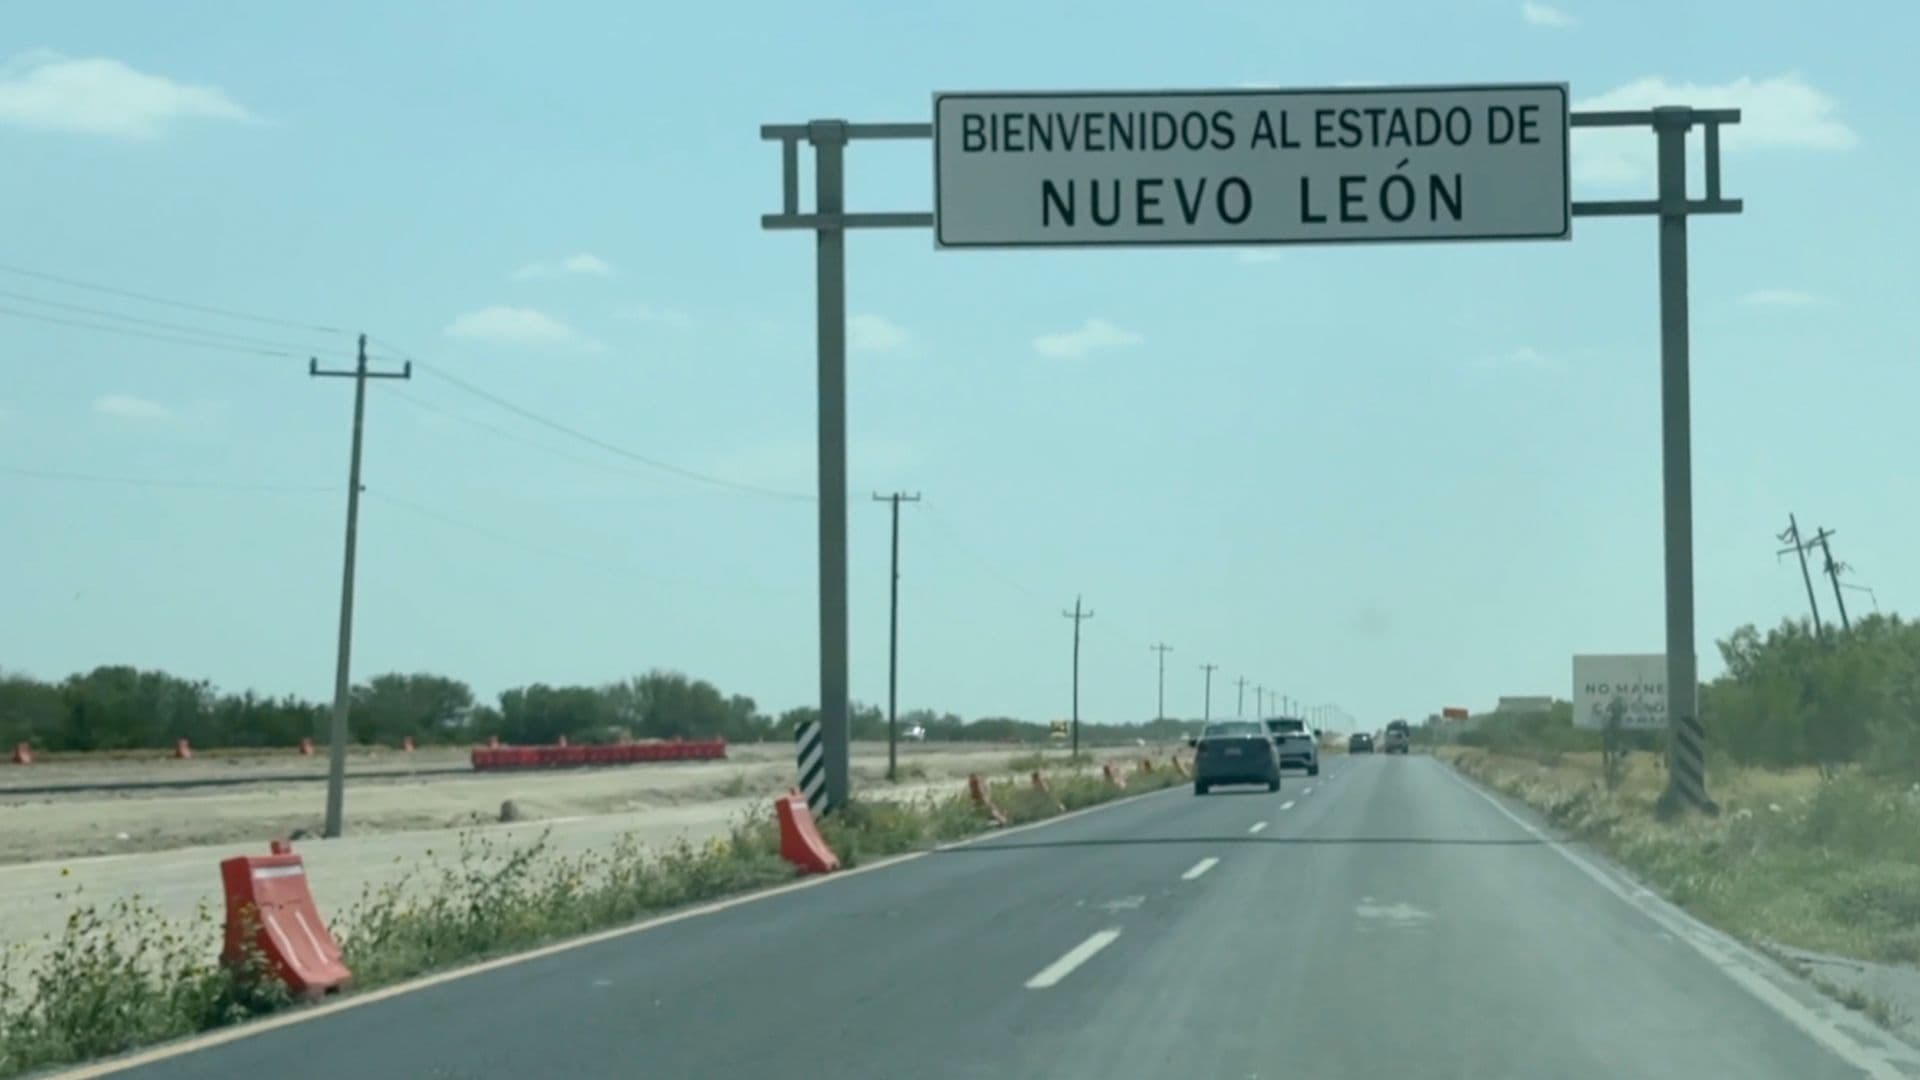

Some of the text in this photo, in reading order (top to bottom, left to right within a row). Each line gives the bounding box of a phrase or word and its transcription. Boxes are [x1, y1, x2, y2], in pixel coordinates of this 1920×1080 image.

[961, 104, 1542, 153] BIENVENIDOS AL ESTADO DE
[1041, 157, 1464, 228] NUEVO LEÓN
[1585, 683, 1609, 695] NO
